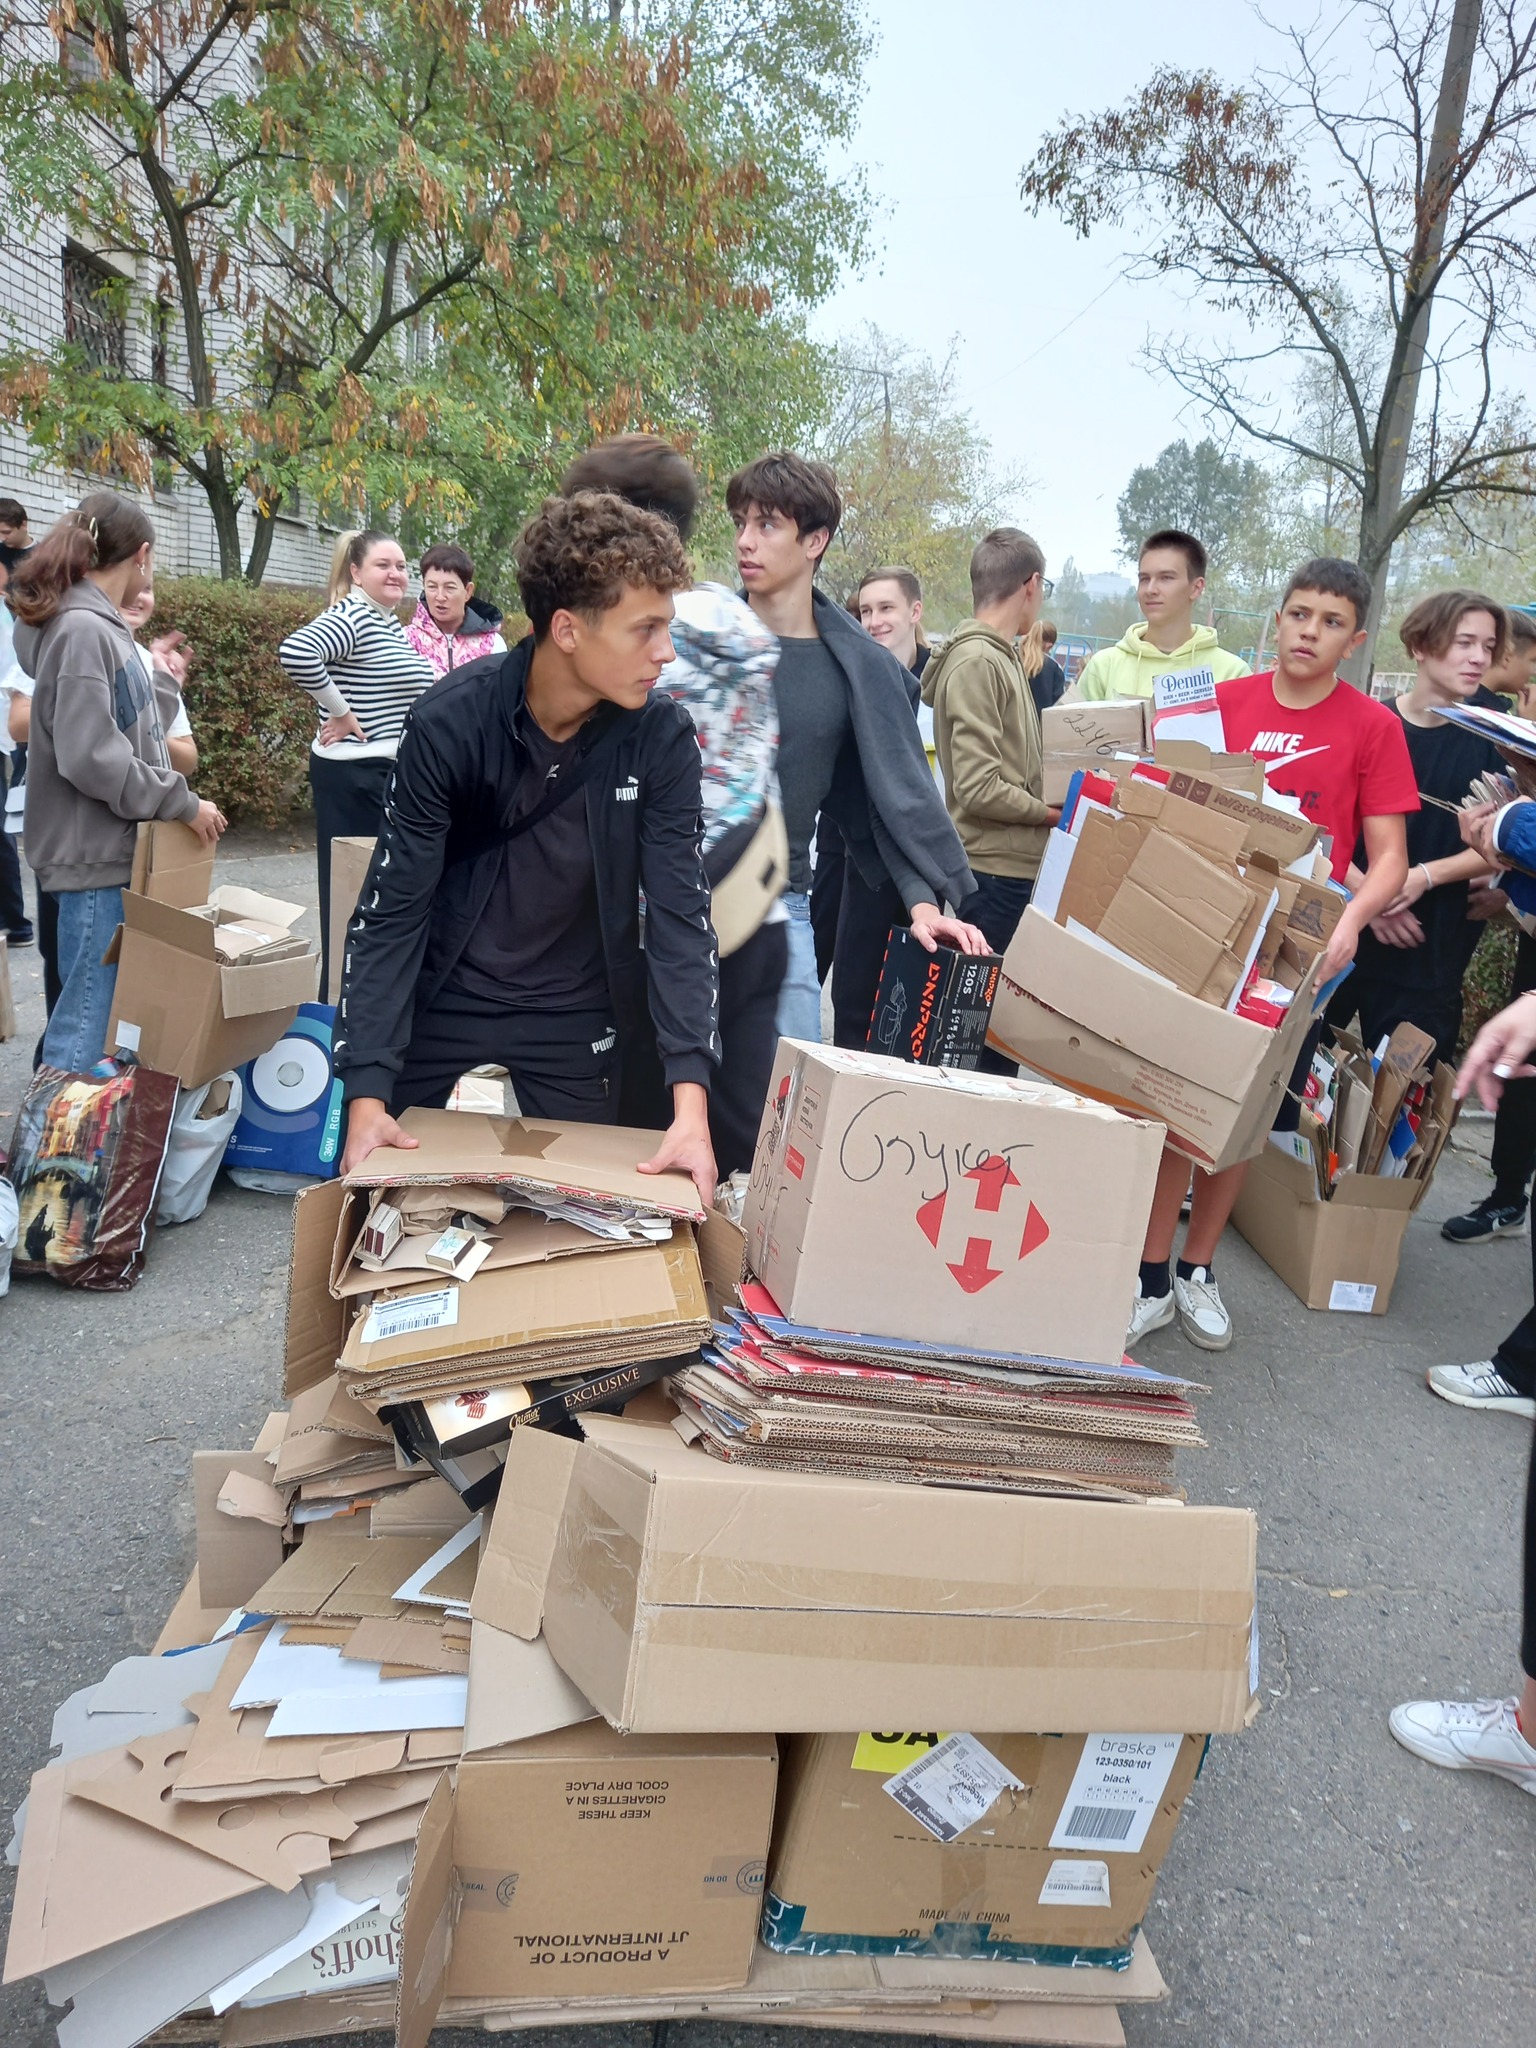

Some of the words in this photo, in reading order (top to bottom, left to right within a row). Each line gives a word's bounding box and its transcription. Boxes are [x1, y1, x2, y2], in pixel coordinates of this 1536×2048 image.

[1194, 686, 1213, 695] CERVEZA
[1063, 713, 1121, 755] 2246
[1250, 731, 1304, 754] NIKE
[1213, 792, 1304, 836] Volfas-Engelman
[962, 964, 978, 996] 120S
[329, 1109, 341, 1130] RGB
[323, 1137, 335, 1158] 36W
[564, 1368, 641, 1408] EXCLUSIVE
[1100, 1738, 1156, 1756] braska
[1095, 1756, 1151, 1769] 123-0350/101
[1103, 1773, 1131, 1784] black
[565, 1782, 605, 1791] PLACE
[607, 1781, 632, 1791] DRY
[636, 1781, 669, 1790] COOL
[566, 1796, 574, 1805] A
[577, 1796, 589, 1805] IN
[592, 1795, 666, 1805] CIGARETTES
[578, 1810, 616, 1820] THESE
[620, 1809, 651, 1819] KEEP
[919, 1908, 950, 1920] MADE
[976, 1912, 1011, 1923] CHINA
[356, 1920, 377, 1930] SEIT
[514, 1932, 663, 1948] INTERNATIONAL
[667, 1931, 690, 1943] JT
[530, 1952, 555, 1965] OF
[560, 1950, 652, 1964] PRODUCT
[658, 1949, 670, 1961] A
